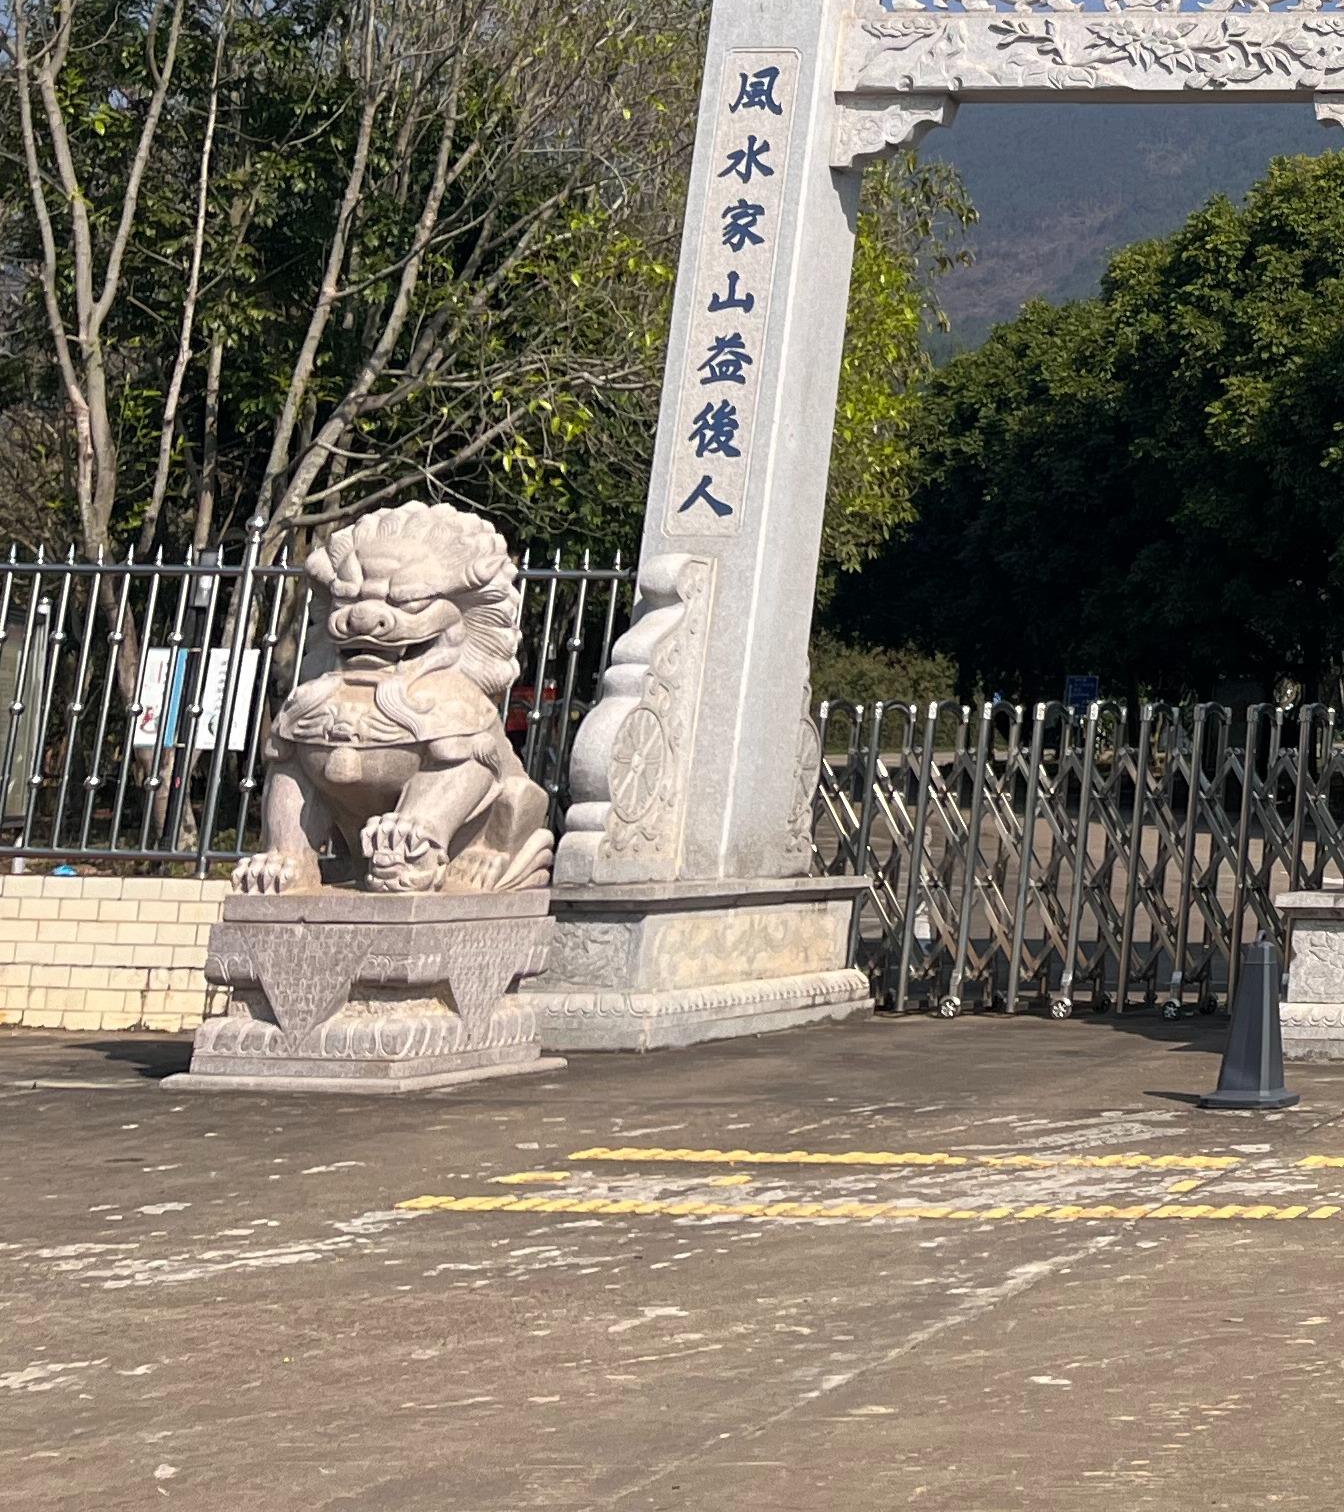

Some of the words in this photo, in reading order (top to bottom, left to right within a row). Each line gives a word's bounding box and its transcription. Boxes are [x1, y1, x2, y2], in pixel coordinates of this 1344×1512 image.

[678, 65, 784, 518] 風水家山益後人
